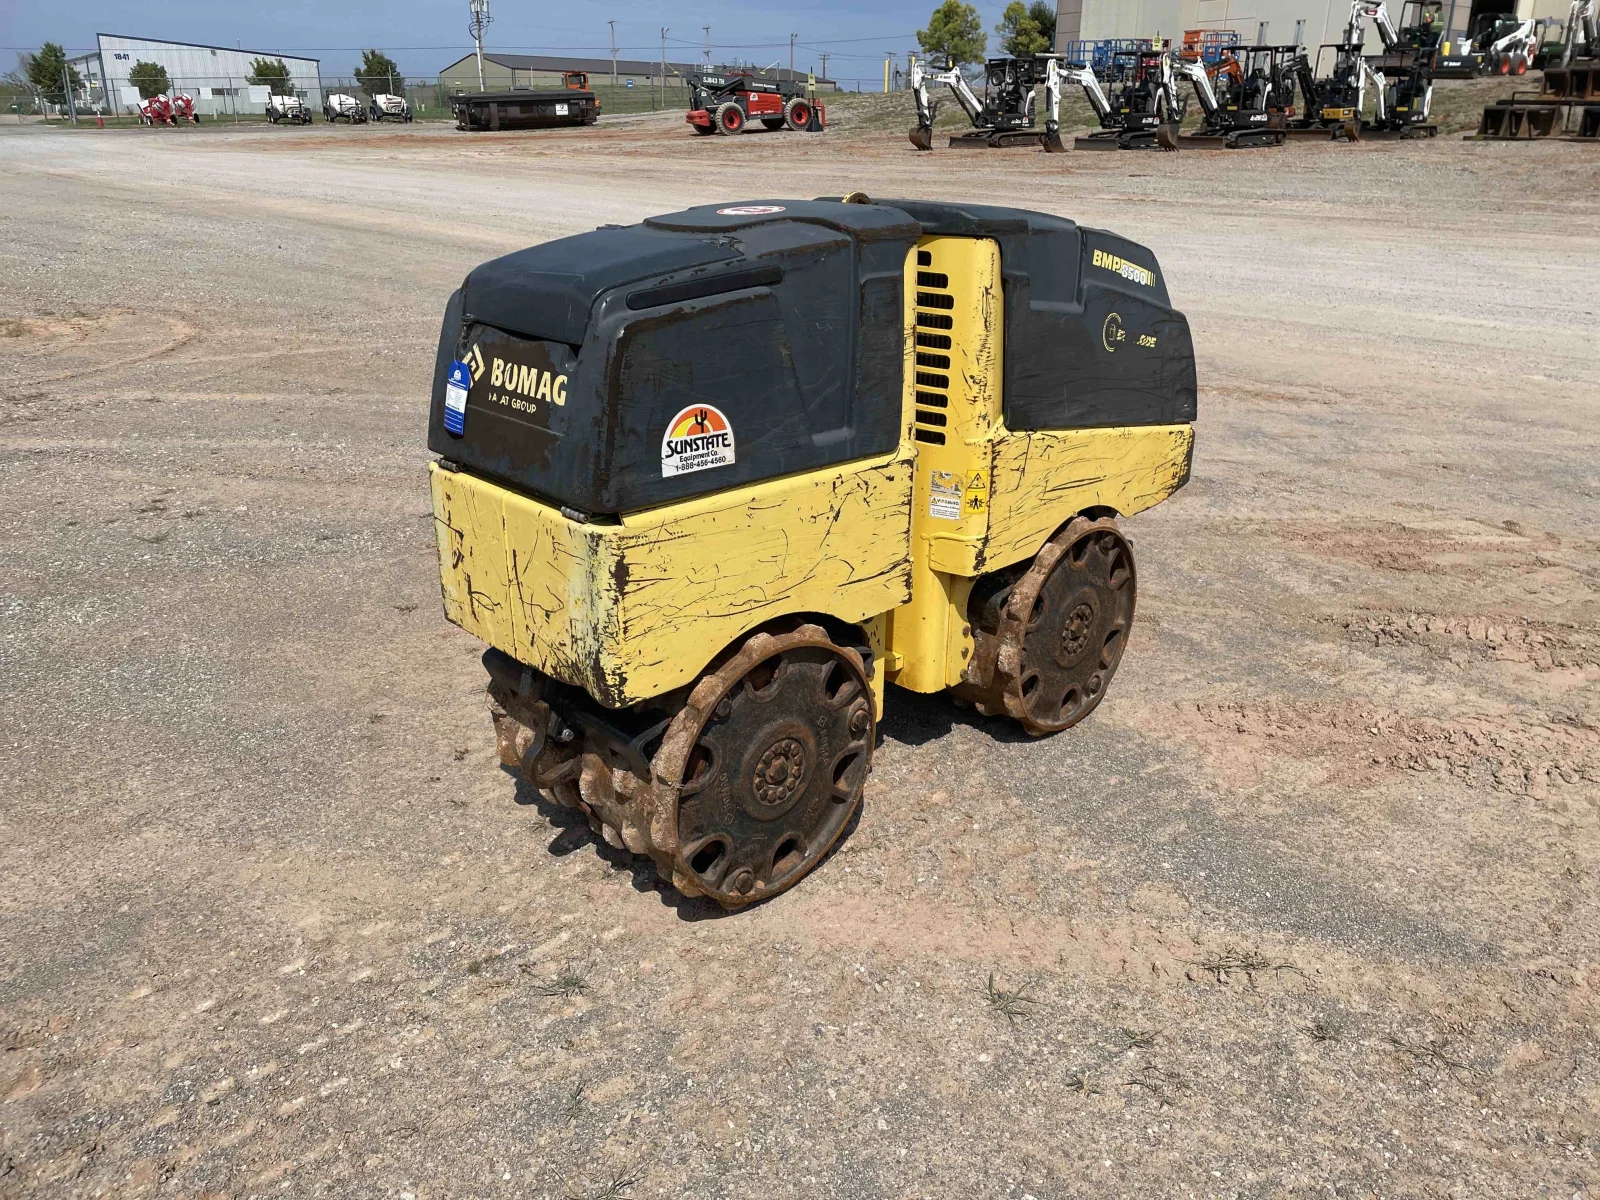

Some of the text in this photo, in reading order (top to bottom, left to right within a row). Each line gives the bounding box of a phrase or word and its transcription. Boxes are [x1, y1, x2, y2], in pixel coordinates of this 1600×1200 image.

[1093, 249, 1147, 285] BMP 8500
[511, 398, 537, 414] GROUP
[665, 433, 731, 458] SUNSTATE
[680, 450, 710, 463] Equipment
